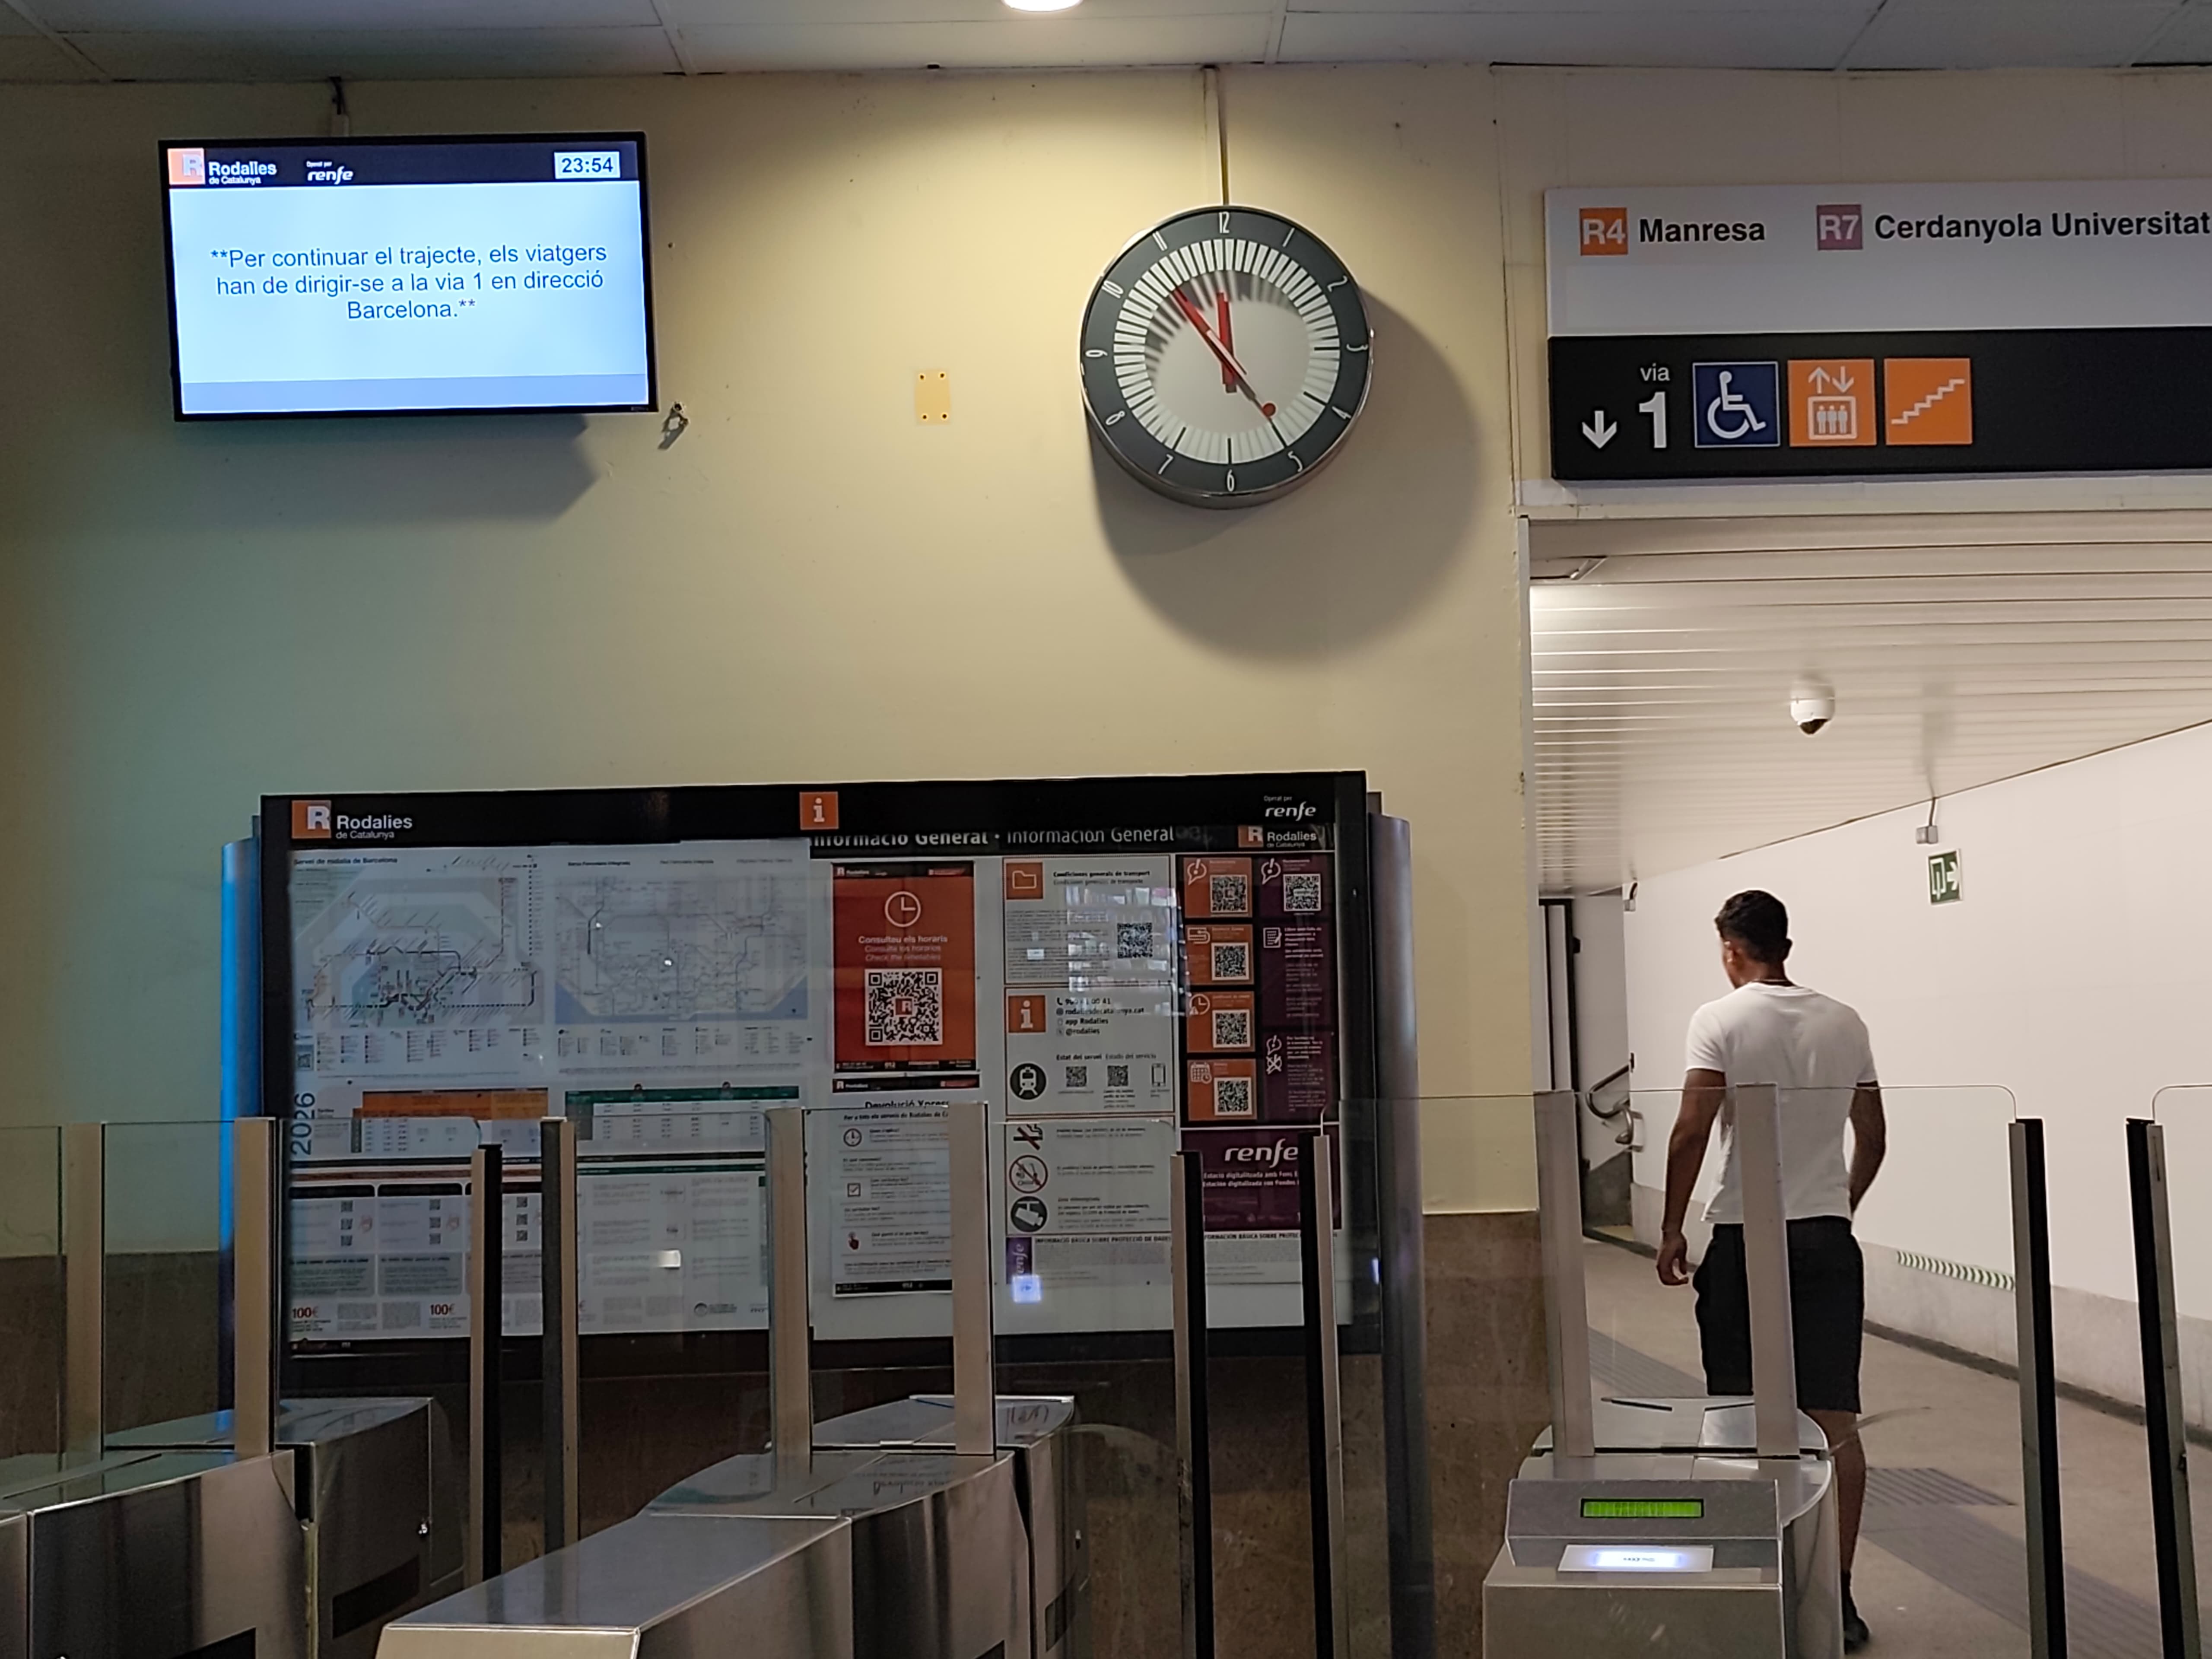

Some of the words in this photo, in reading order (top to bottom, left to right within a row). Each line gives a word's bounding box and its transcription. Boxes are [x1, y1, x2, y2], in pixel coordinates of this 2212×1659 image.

[307, 166, 353, 184] renfe
[561, 157, 614, 174] 23:54
[1219, 212, 1230, 234] 12
[1582, 219, 1626, 245] R4
[1639, 218, 1766, 243] Manresa
[1819, 214, 1859, 241] R7
[1874, 213, 2042, 245] Cerdanyola
[2051, 210, 2210, 238] Universitat
[1152, 231, 1167, 251] 11
[272, 247, 369, 267] continuar
[375, 245, 393, 264] el
[399, 245, 482, 269] trajecte,
[489, 244, 519, 263] els
[524, 243, 607, 269] viatgers
[216, 275, 256, 295] han
[262, 274, 288, 294] de
[295, 273, 385, 299] dirigir-se
[391, 277, 404, 292] a
[410, 272, 429, 292] la
[435, 272, 464, 291] via
[473, 272, 482, 290] 1
[491, 275, 517, 290] en
[523, 270, 604, 290] direcció
[1102, 280, 1124, 299] 10
[1327, 275, 1348, 292] 2
[1085, 349, 1108, 358] 9
[1346, 343, 1368, 353] 3
[1640, 364, 1670, 382] via
[1105, 411, 1125, 426] 8
[1331, 406, 1351, 420] 4
[1639, 391, 1667, 448] 1
[1158, 454, 1174, 475] 7
[1288, 451, 1303, 472] 5
[1227, 469, 1235, 492] 6
[307, 806, 331, 830] R
[1265, 801, 1316, 821] renfe
[337, 815, 413, 829] Rodalies
[336, 831, 347, 839] de
[350, 830, 394, 840] Catalunya
[1111, 826, 1175, 843] General
[1267, 832, 1317, 842] Rodalies
[290, 1092, 315, 1156] 2026
[1224, 1138, 1298, 1168] renfe
